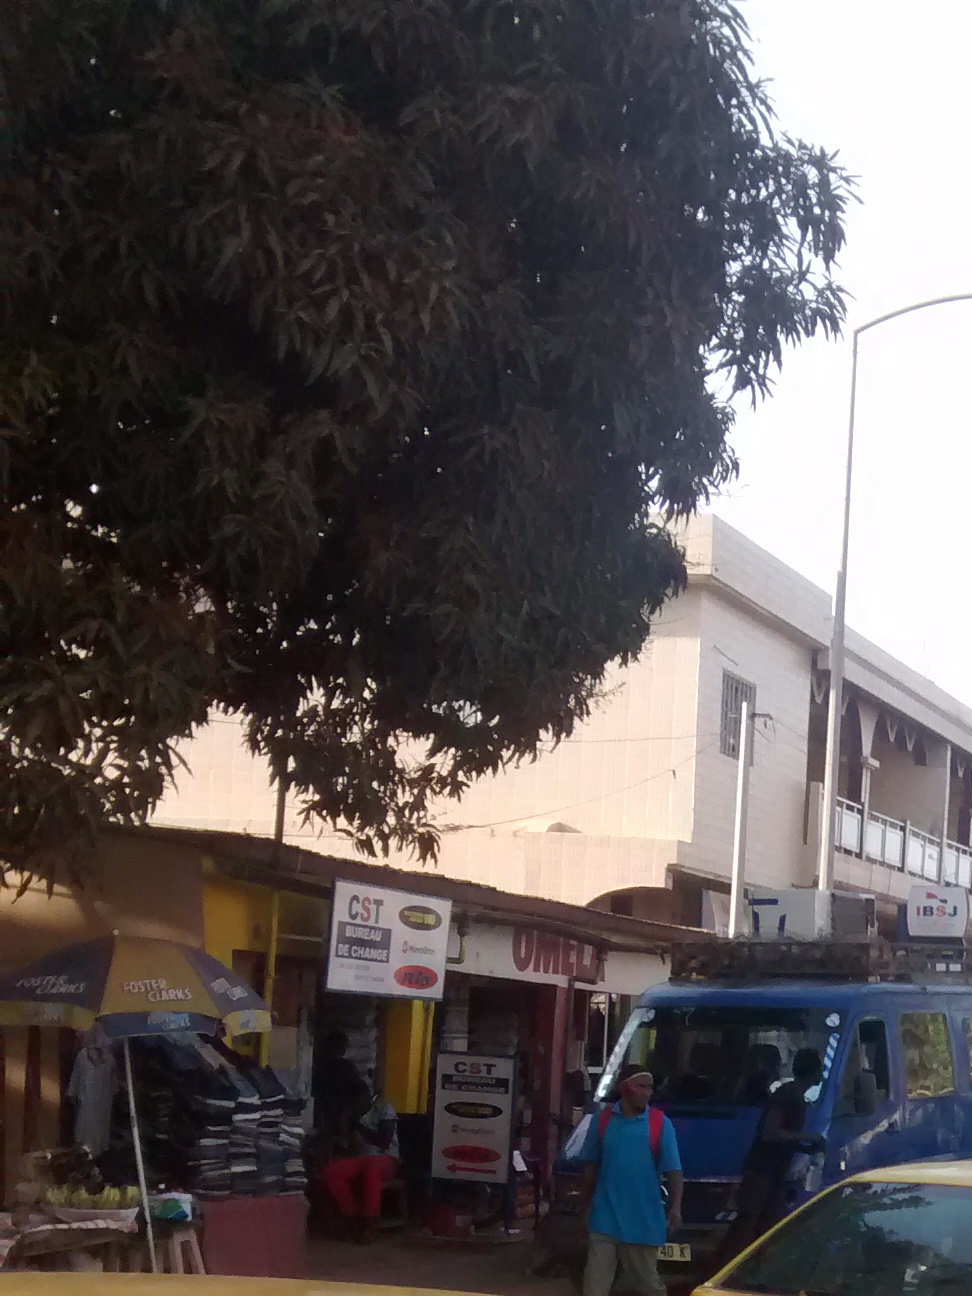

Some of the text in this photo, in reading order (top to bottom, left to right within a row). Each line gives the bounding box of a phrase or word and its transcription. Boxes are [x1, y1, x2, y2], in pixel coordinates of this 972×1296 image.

[348, 894, 384, 924] CST
[916, 905, 958, 917] IBSJ
[345, 925, 382, 942] BUREAU
[337, 943, 388, 961] DE CHANGE
[123, 978, 167, 993] FOSTER
[147, 988, 192, 1001] CLARKS
[454, 1061, 496, 1075] CST
